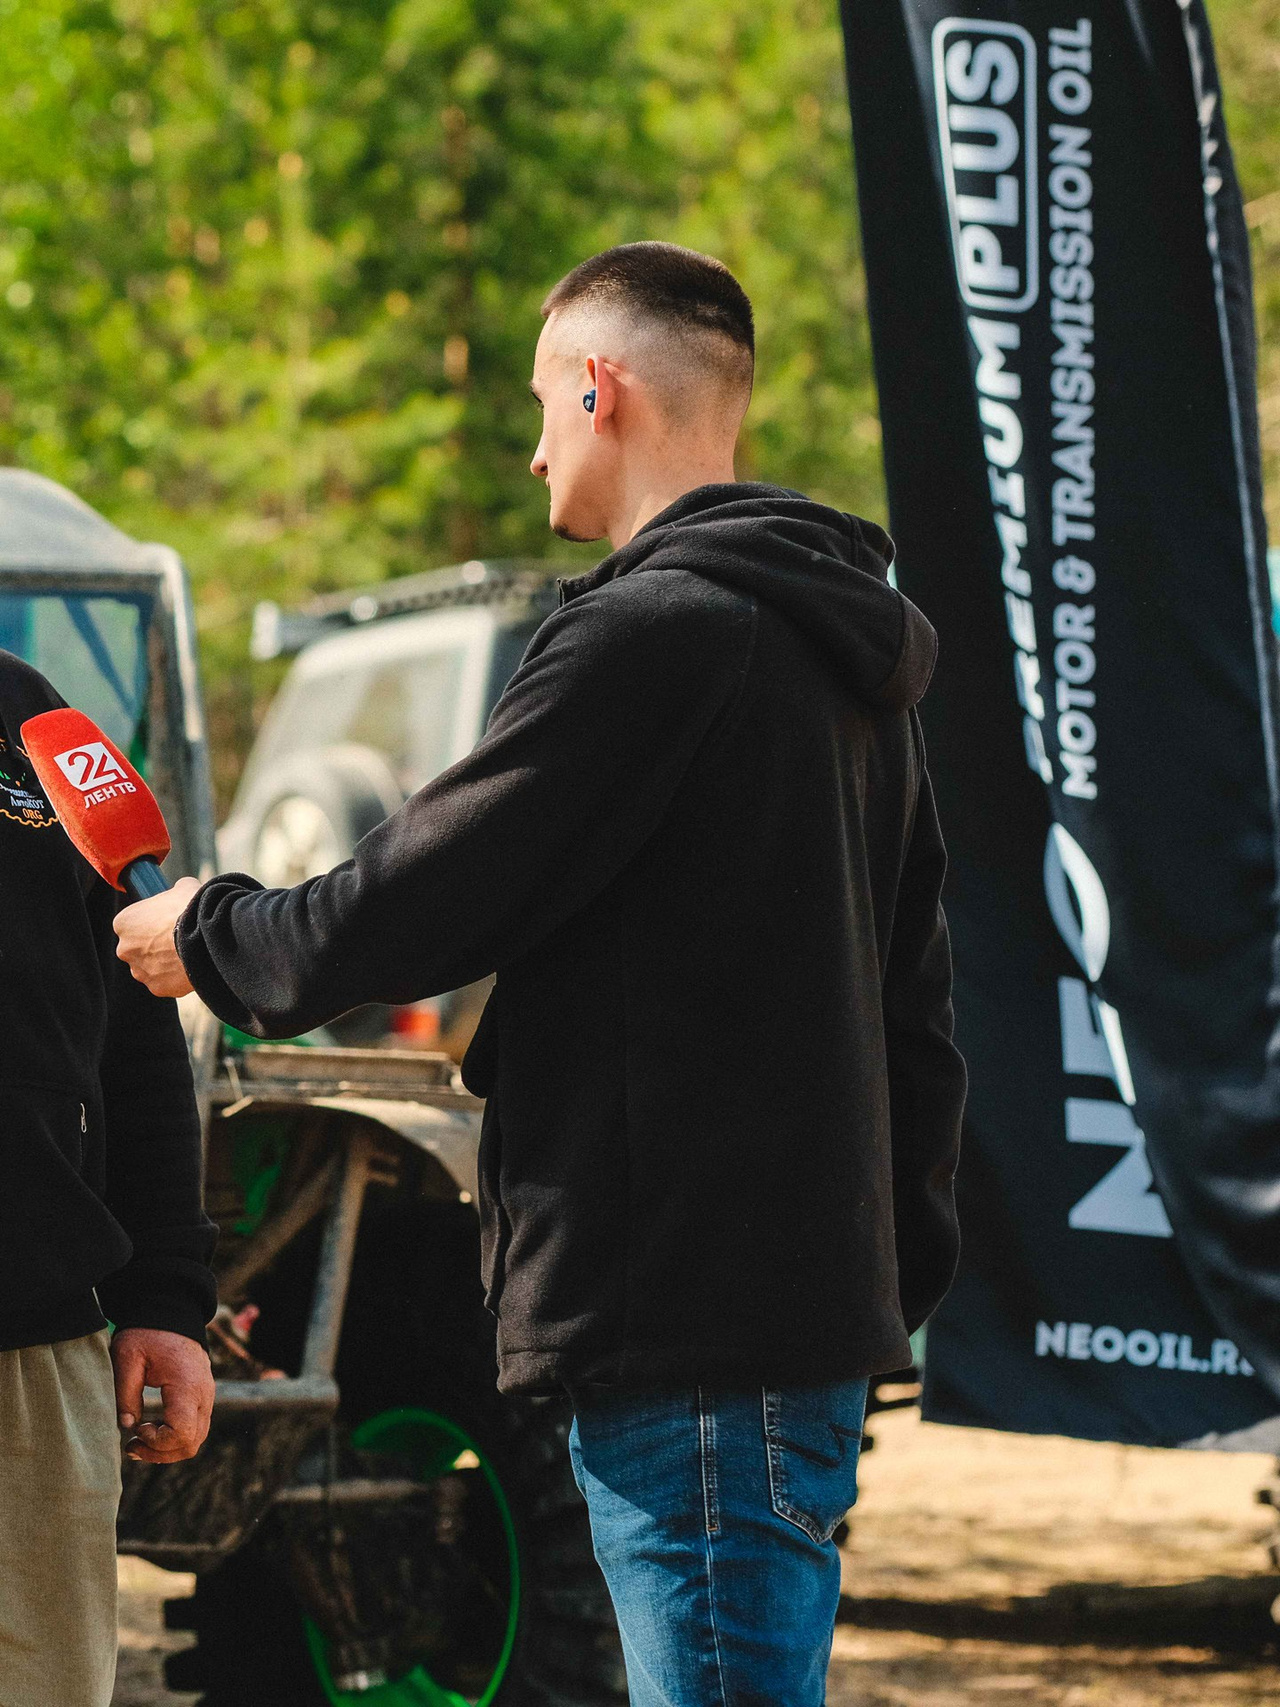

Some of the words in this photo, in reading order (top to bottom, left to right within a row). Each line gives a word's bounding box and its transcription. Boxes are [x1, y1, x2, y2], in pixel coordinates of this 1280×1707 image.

[1047, 17, 1093, 116] OIL
[944, 39, 1020, 293] PLUS
[1048, 124, 1096, 546] TRANSMISSION
[1051, 558, 1096, 594] &
[1053, 602, 1098, 800] MOTOR
[22, 808, 43, 820] ORG
[67, 750, 125, 787] 24
